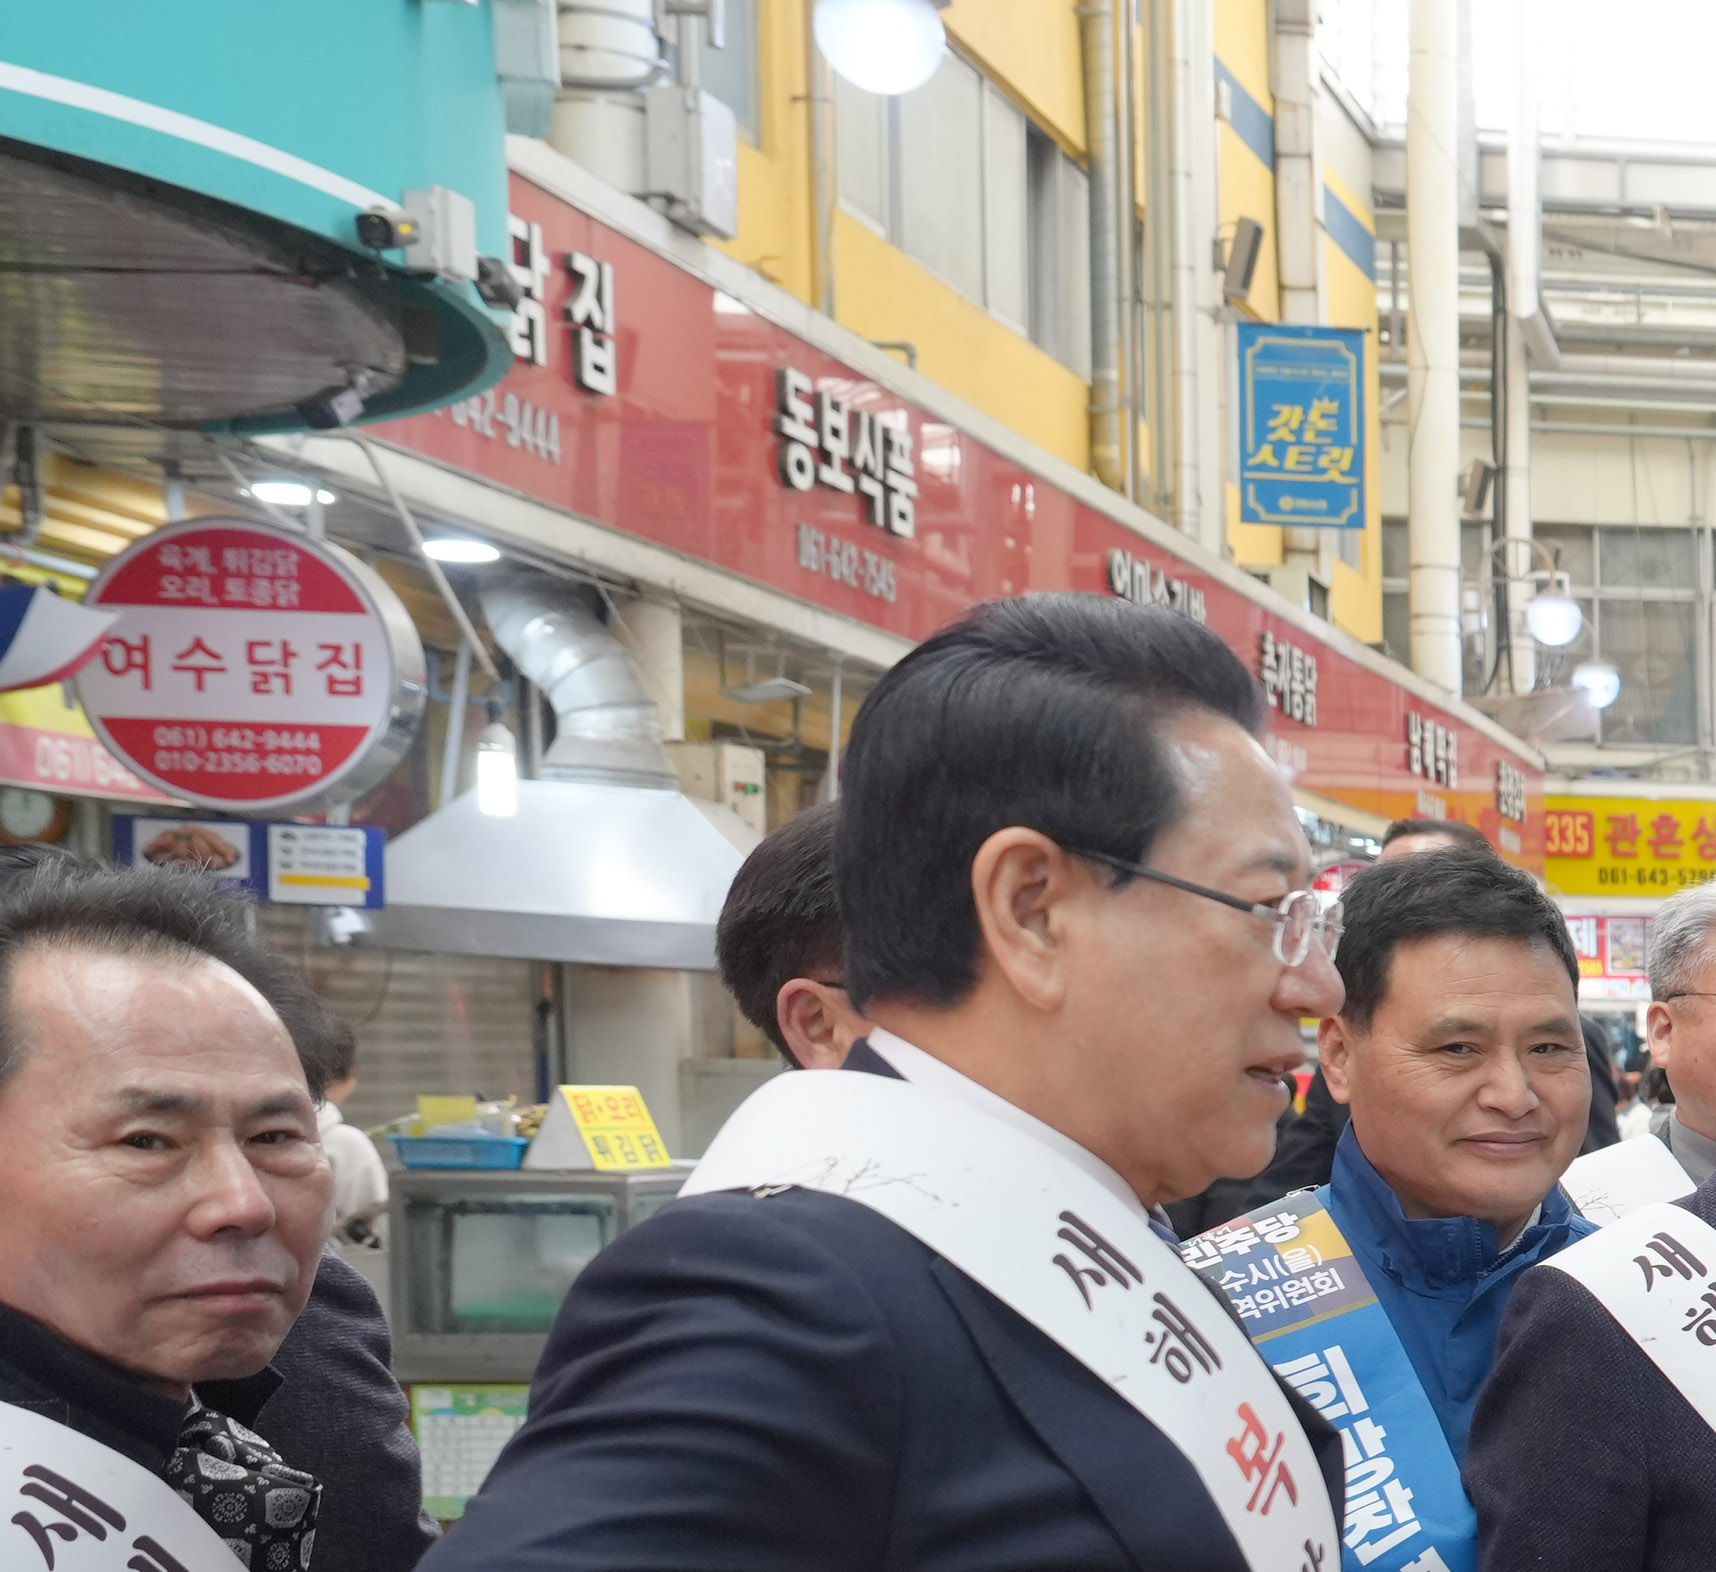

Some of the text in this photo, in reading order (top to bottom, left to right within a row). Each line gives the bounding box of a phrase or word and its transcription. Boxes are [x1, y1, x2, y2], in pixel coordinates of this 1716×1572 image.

[780, 366, 919, 540] 동보식품
[100, 633, 365, 698] 여수닭집
[1545, 812, 1590, 851] 335
[1217, 1244, 1323, 1294] 수시(을)
[1051, 1209, 1224, 1386] 새해
[1224, 1401, 1300, 1517] 복
